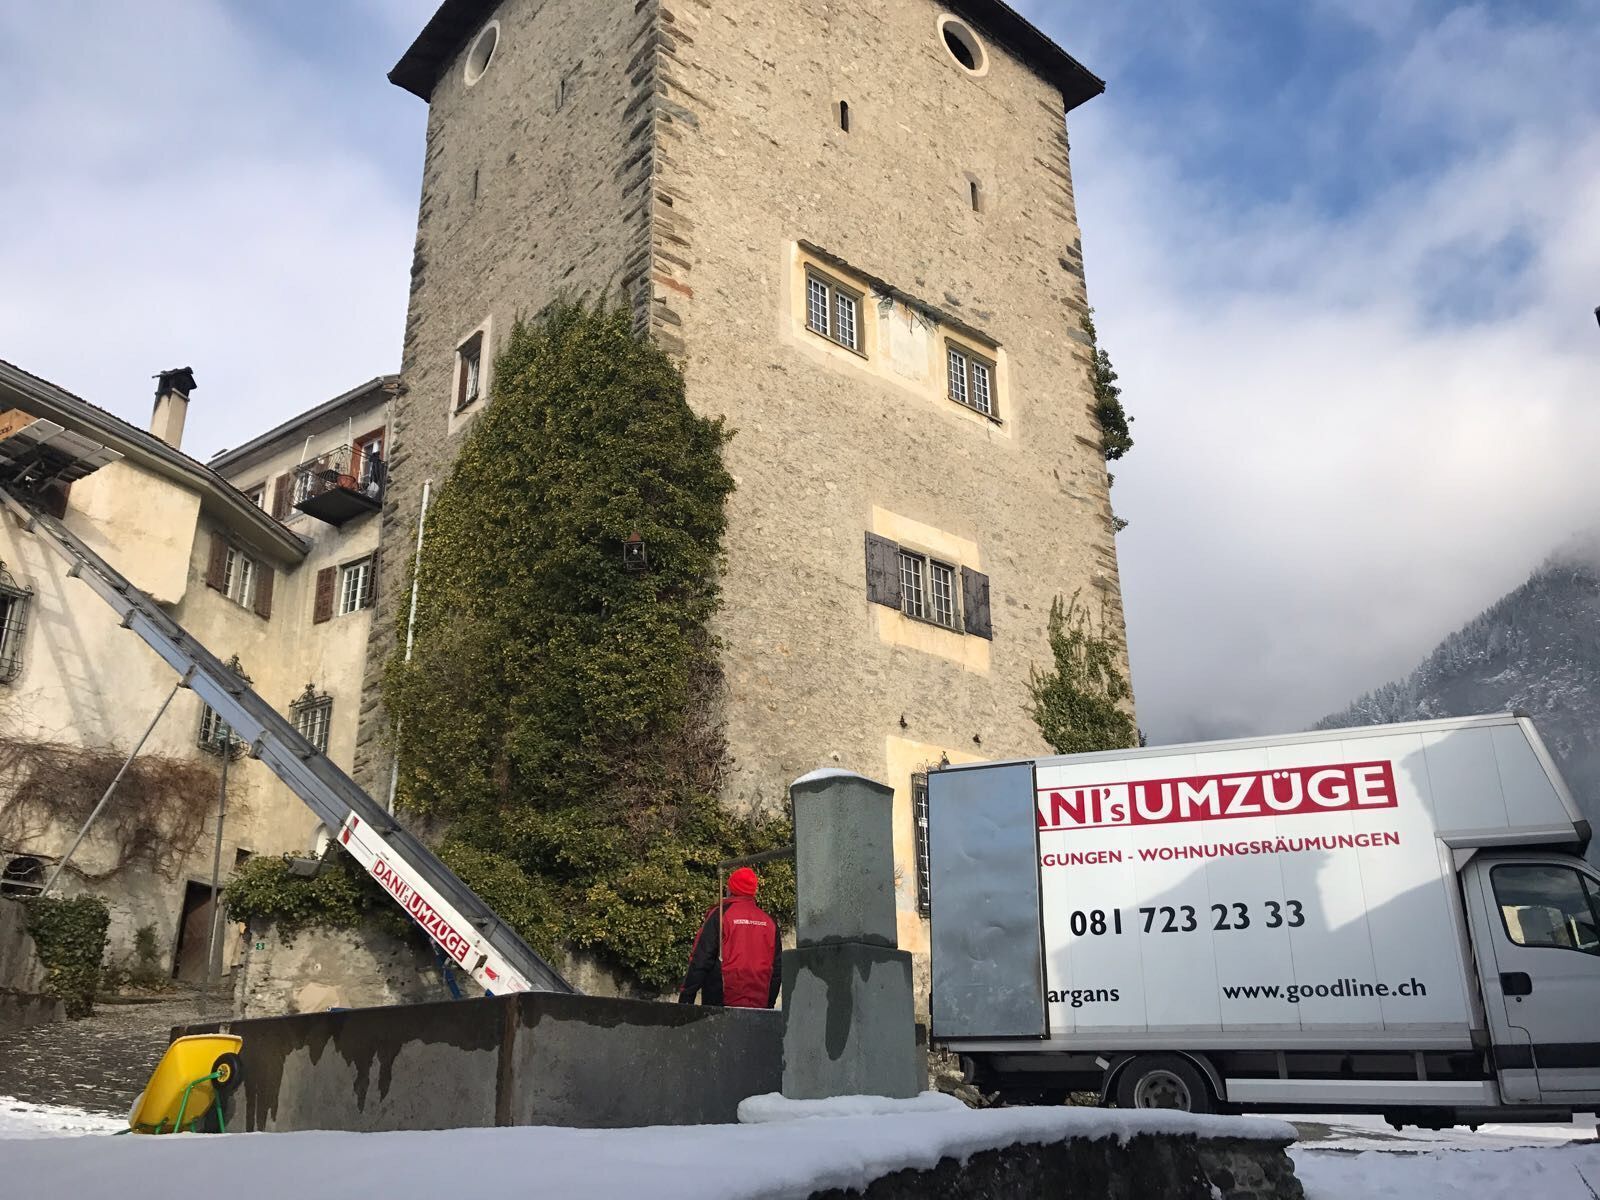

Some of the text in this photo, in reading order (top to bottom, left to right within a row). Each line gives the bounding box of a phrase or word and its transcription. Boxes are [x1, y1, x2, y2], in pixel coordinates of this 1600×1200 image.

[1038, 766, 1388, 826] NI's UMZÜGE
[1041, 850, 1122, 867] GUNGEN
[1138, 831, 1400, 861] WOHNUNGSRÄUMUNGEN
[1070, 900, 1305, 936] 081 723 23 33
[1222, 978, 1427, 1003] www.goodline.ch
